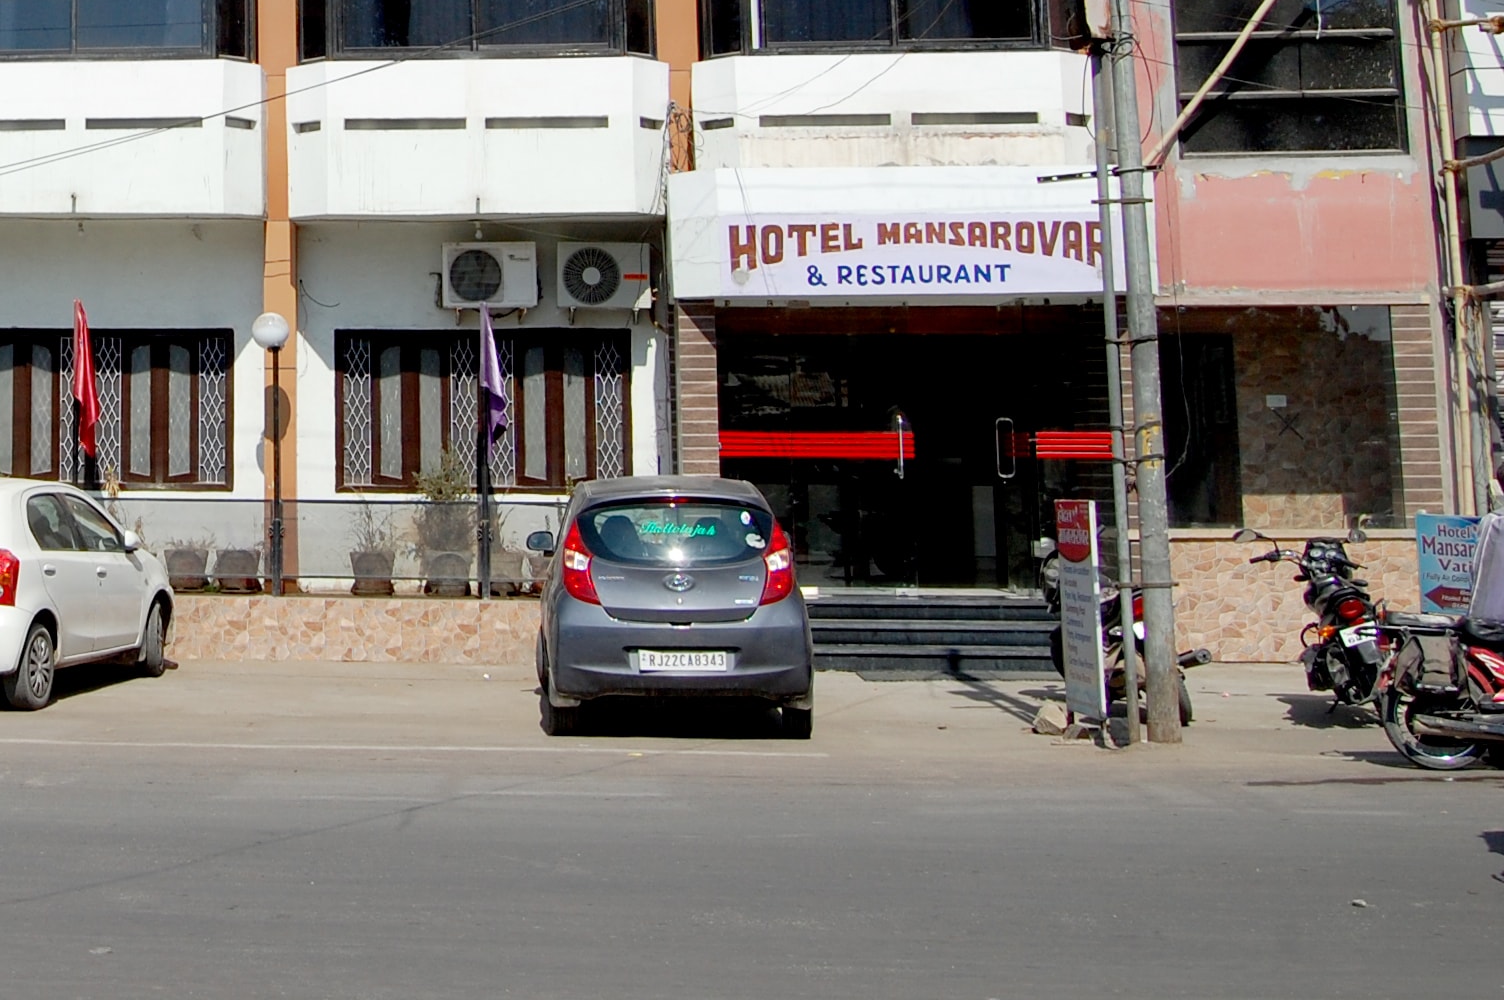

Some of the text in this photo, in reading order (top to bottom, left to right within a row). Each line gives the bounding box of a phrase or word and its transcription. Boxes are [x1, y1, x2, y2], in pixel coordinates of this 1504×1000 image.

[729, 220, 1102, 273] HOTEL MANSAROVAR
[807, 264, 1011, 287] & RESTAURANT
[1437, 525, 1471, 538] Hotel
[649, 654, 724, 667] RJ22CA8343
